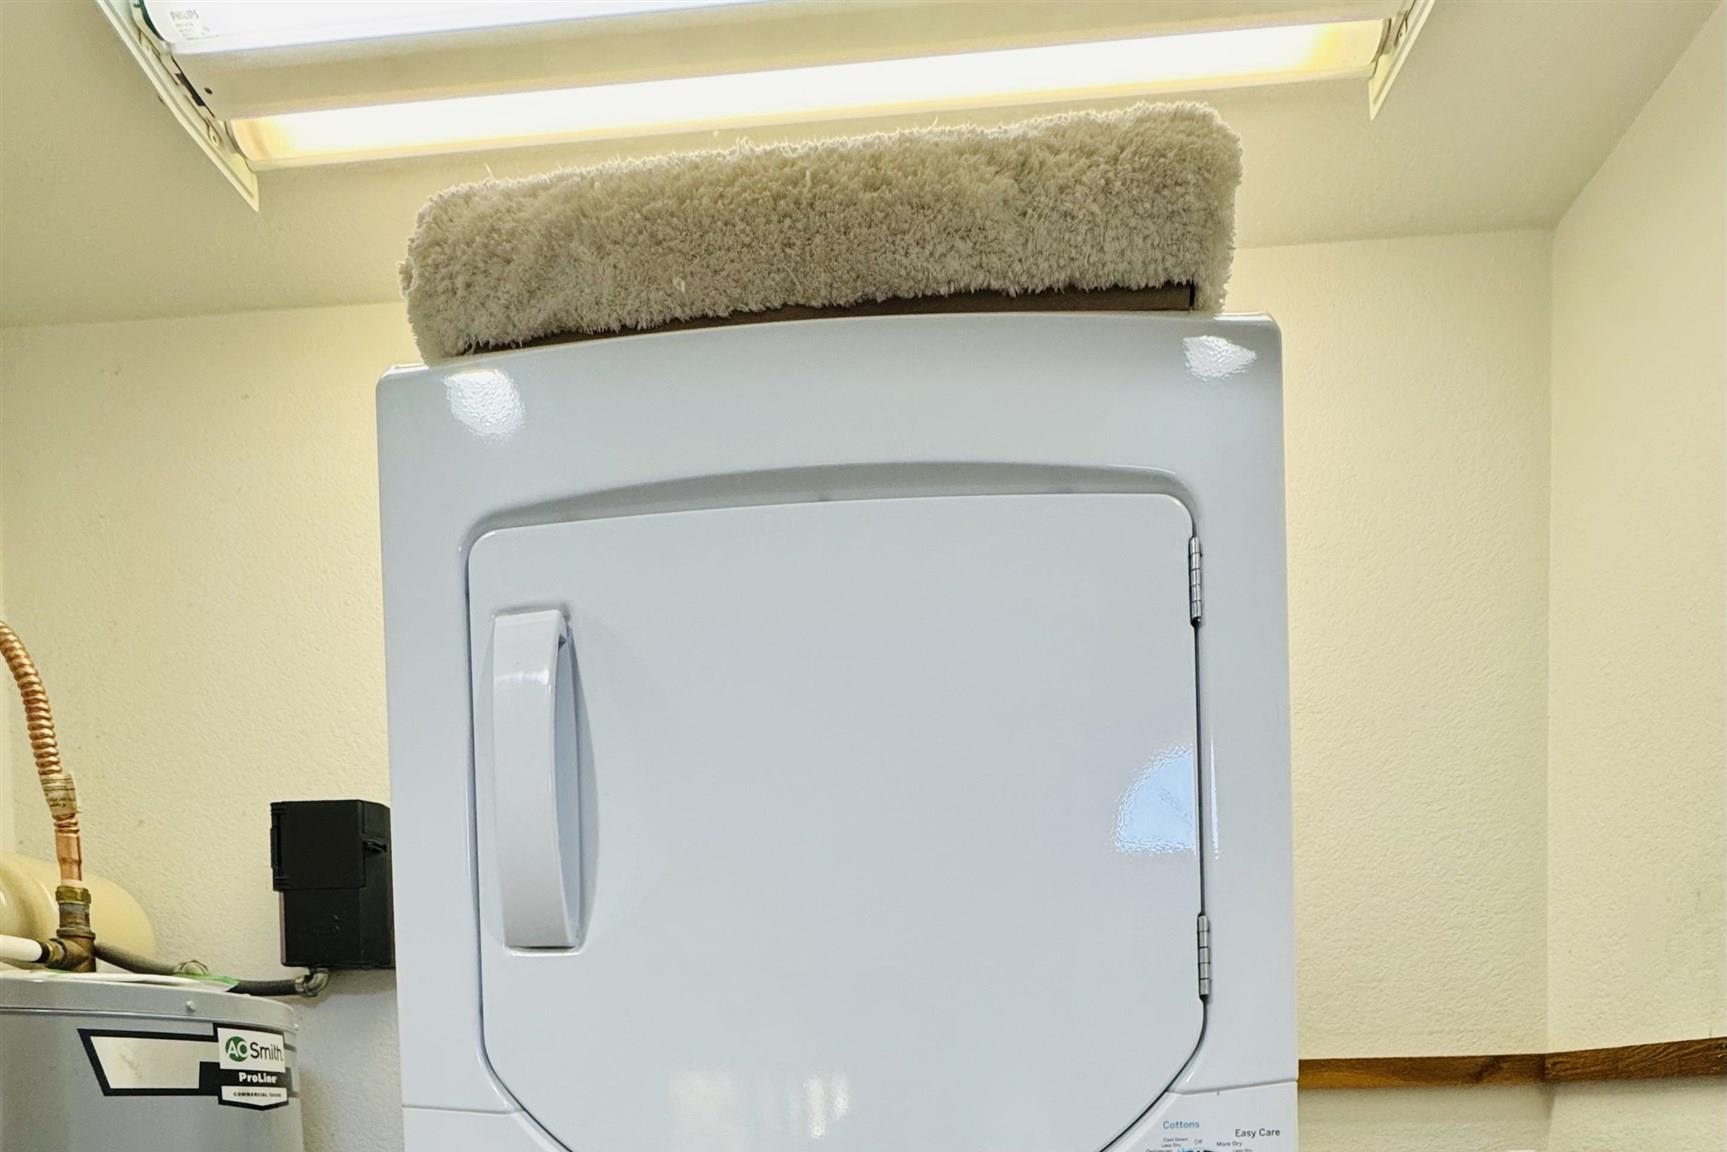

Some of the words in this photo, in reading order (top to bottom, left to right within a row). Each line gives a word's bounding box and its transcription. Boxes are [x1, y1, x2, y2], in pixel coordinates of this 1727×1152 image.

[227, 1039, 249, 1058] AO
[250, 1041, 283, 1061] Smith
[238, 1072, 278, 1084] ProLine
[1162, 1120, 1200, 1129] Cottons
[1235, 1129, 1257, 1139] Easy
[1259, 1128, 1281, 1137] Care
